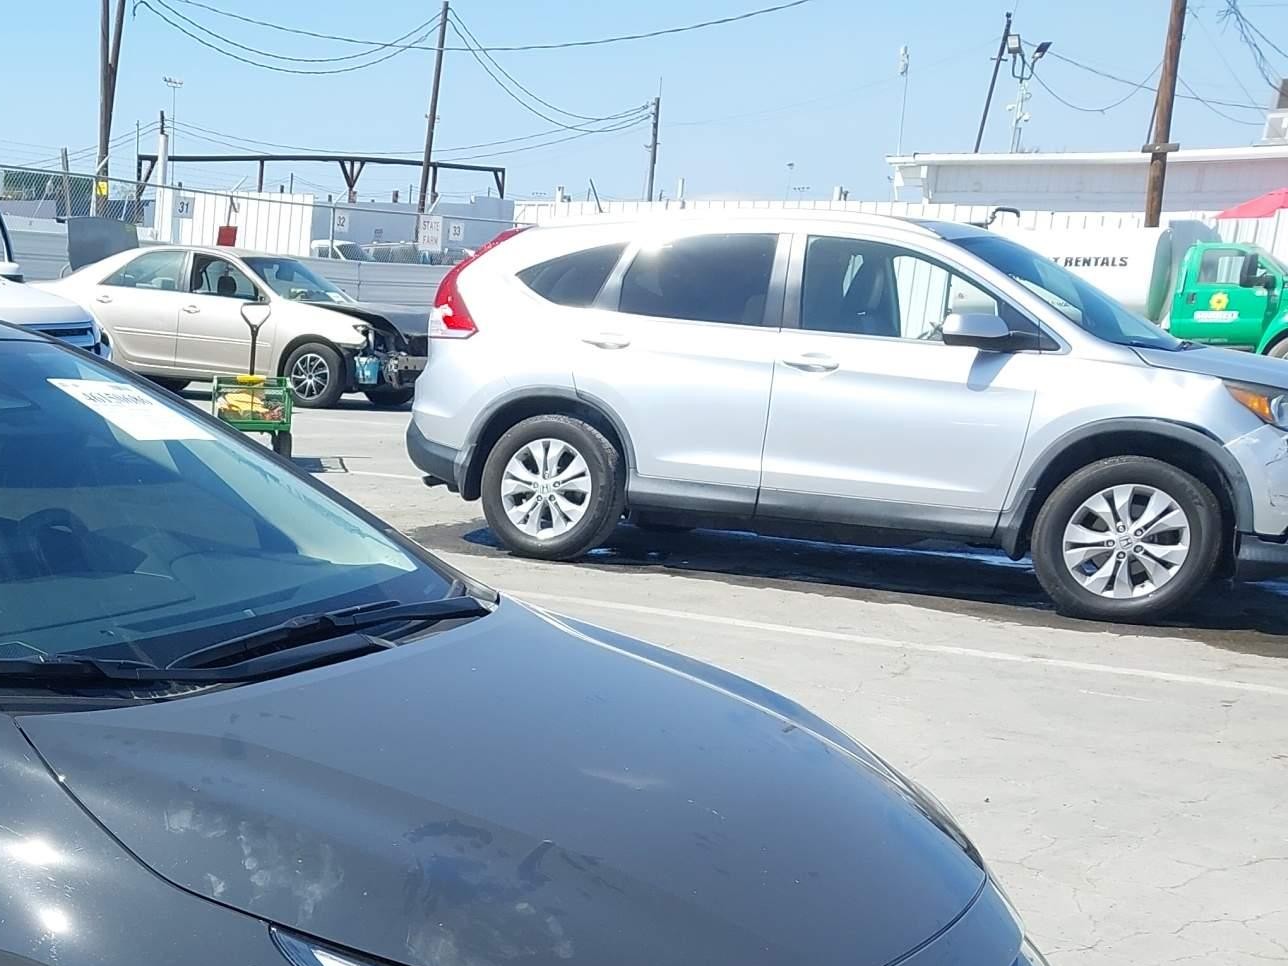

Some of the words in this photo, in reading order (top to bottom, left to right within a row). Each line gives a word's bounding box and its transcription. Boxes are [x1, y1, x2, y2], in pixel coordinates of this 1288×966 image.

[177, 201, 190, 214] 31
[336, 215, 346, 227] 32
[422, 220, 440, 232] STATE
[452, 225, 461, 237] 33
[1063, 256, 1129, 268] RENTALS
